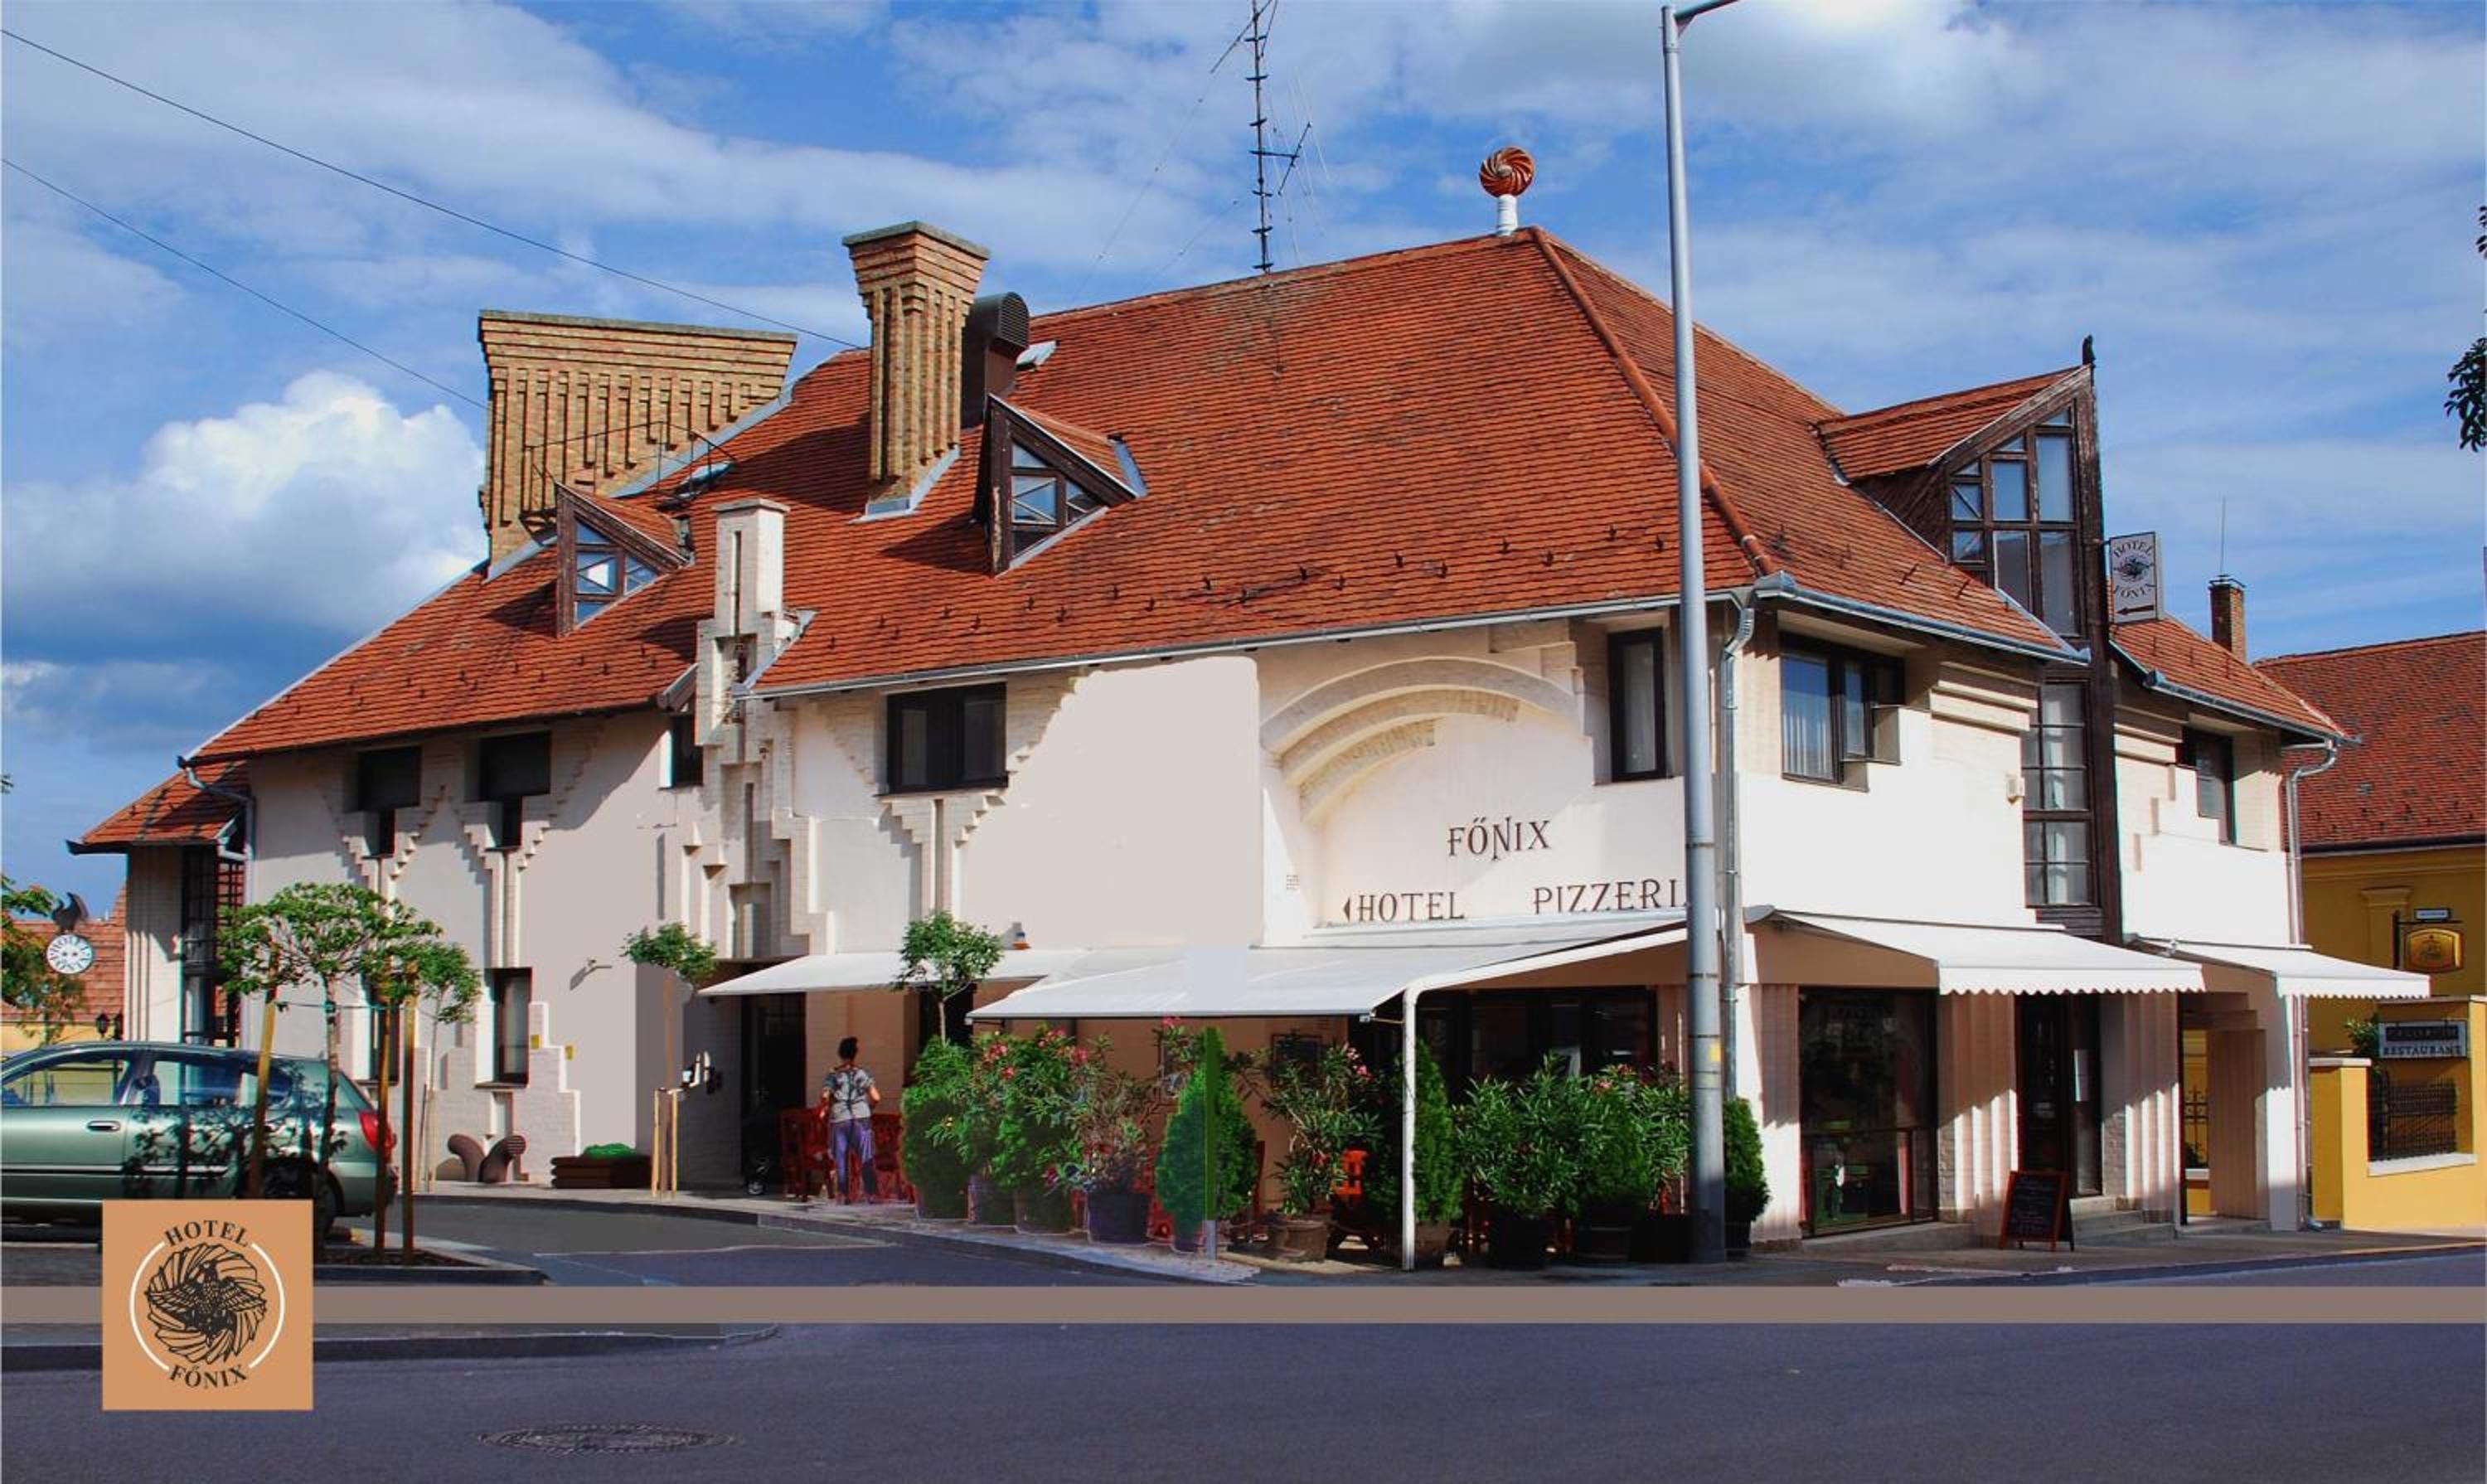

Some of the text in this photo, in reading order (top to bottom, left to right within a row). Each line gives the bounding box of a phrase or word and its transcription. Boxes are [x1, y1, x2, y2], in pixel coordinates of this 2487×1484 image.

[1447, 816, 1552, 861] FŐNIX
[1358, 892, 1465, 923] HOTEL
[1533, 878, 1687, 914] PIZZERI
[2383, 1045, 2460, 1055] RESTAURANT
